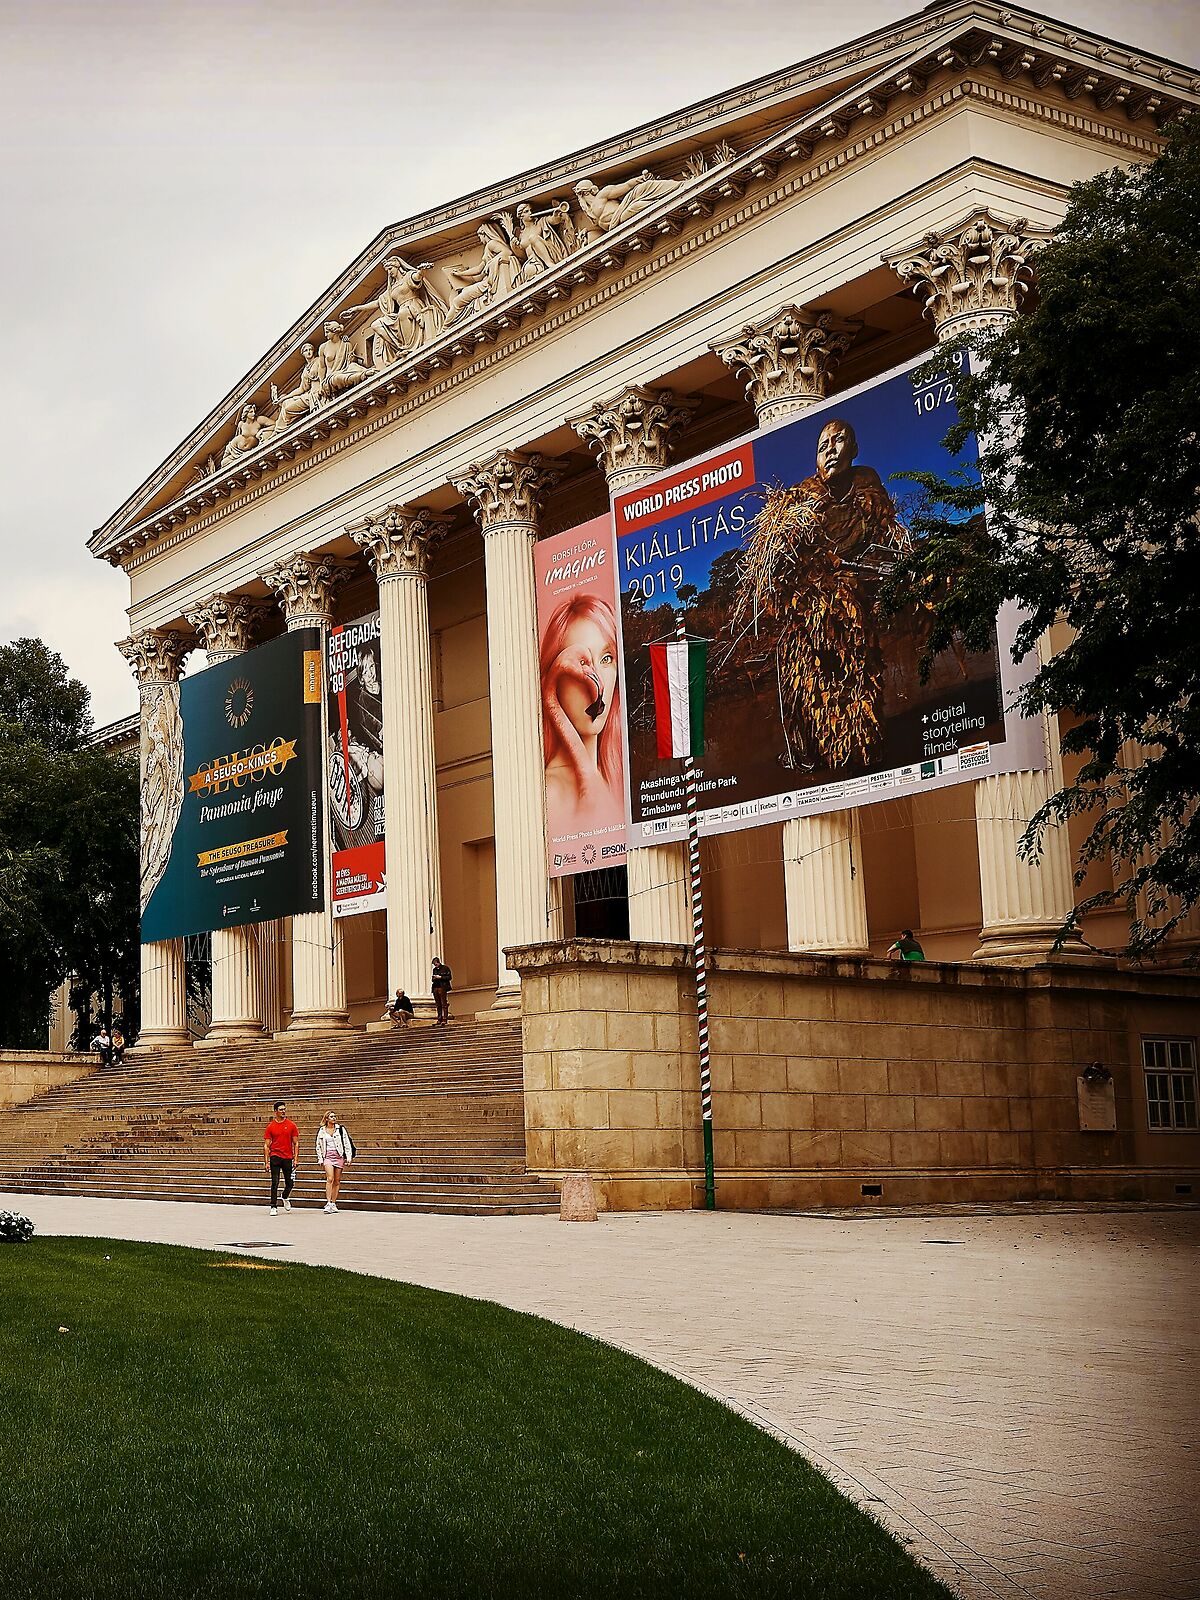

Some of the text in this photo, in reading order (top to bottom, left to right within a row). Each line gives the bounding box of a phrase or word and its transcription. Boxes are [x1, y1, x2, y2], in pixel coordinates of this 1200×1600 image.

[914, 383, 959, 416] 10/2
[623, 459, 743, 522] WORLD PRESS PHOTO
[625, 505, 747, 571] KIÁLLÍTÁS
[552, 539, 598, 563] BORSI FLÓRA
[545, 548, 607, 586] IMAGINE
[628, 564, 684, 604] 2019
[329, 614, 381, 656] BEFOGADÁS
[329, 647, 358, 675] NAPJA
[931, 702, 966, 723] digital
[922, 716, 986, 741] storytelling
[923, 737, 959, 757] filmek
[205, 750, 277, 784] A SEUSO-KINCS
[960, 753, 989, 766] POSTCODE
[640, 775, 681, 791] Akashinga
[641, 787, 685, 804] Phundundu
[717, 775, 738, 788] Park
[200, 787, 284, 824] Pannonia fénye
[641, 802, 682, 817] Zimbabwe
[742, 804, 758, 816] ELLE
[760, 801, 777, 811] Forbes
[798, 797, 820, 805] TAMRON
[209, 837, 275, 861] THE SEUSO TREASURE
[601, 842, 626, 856] EPSON
